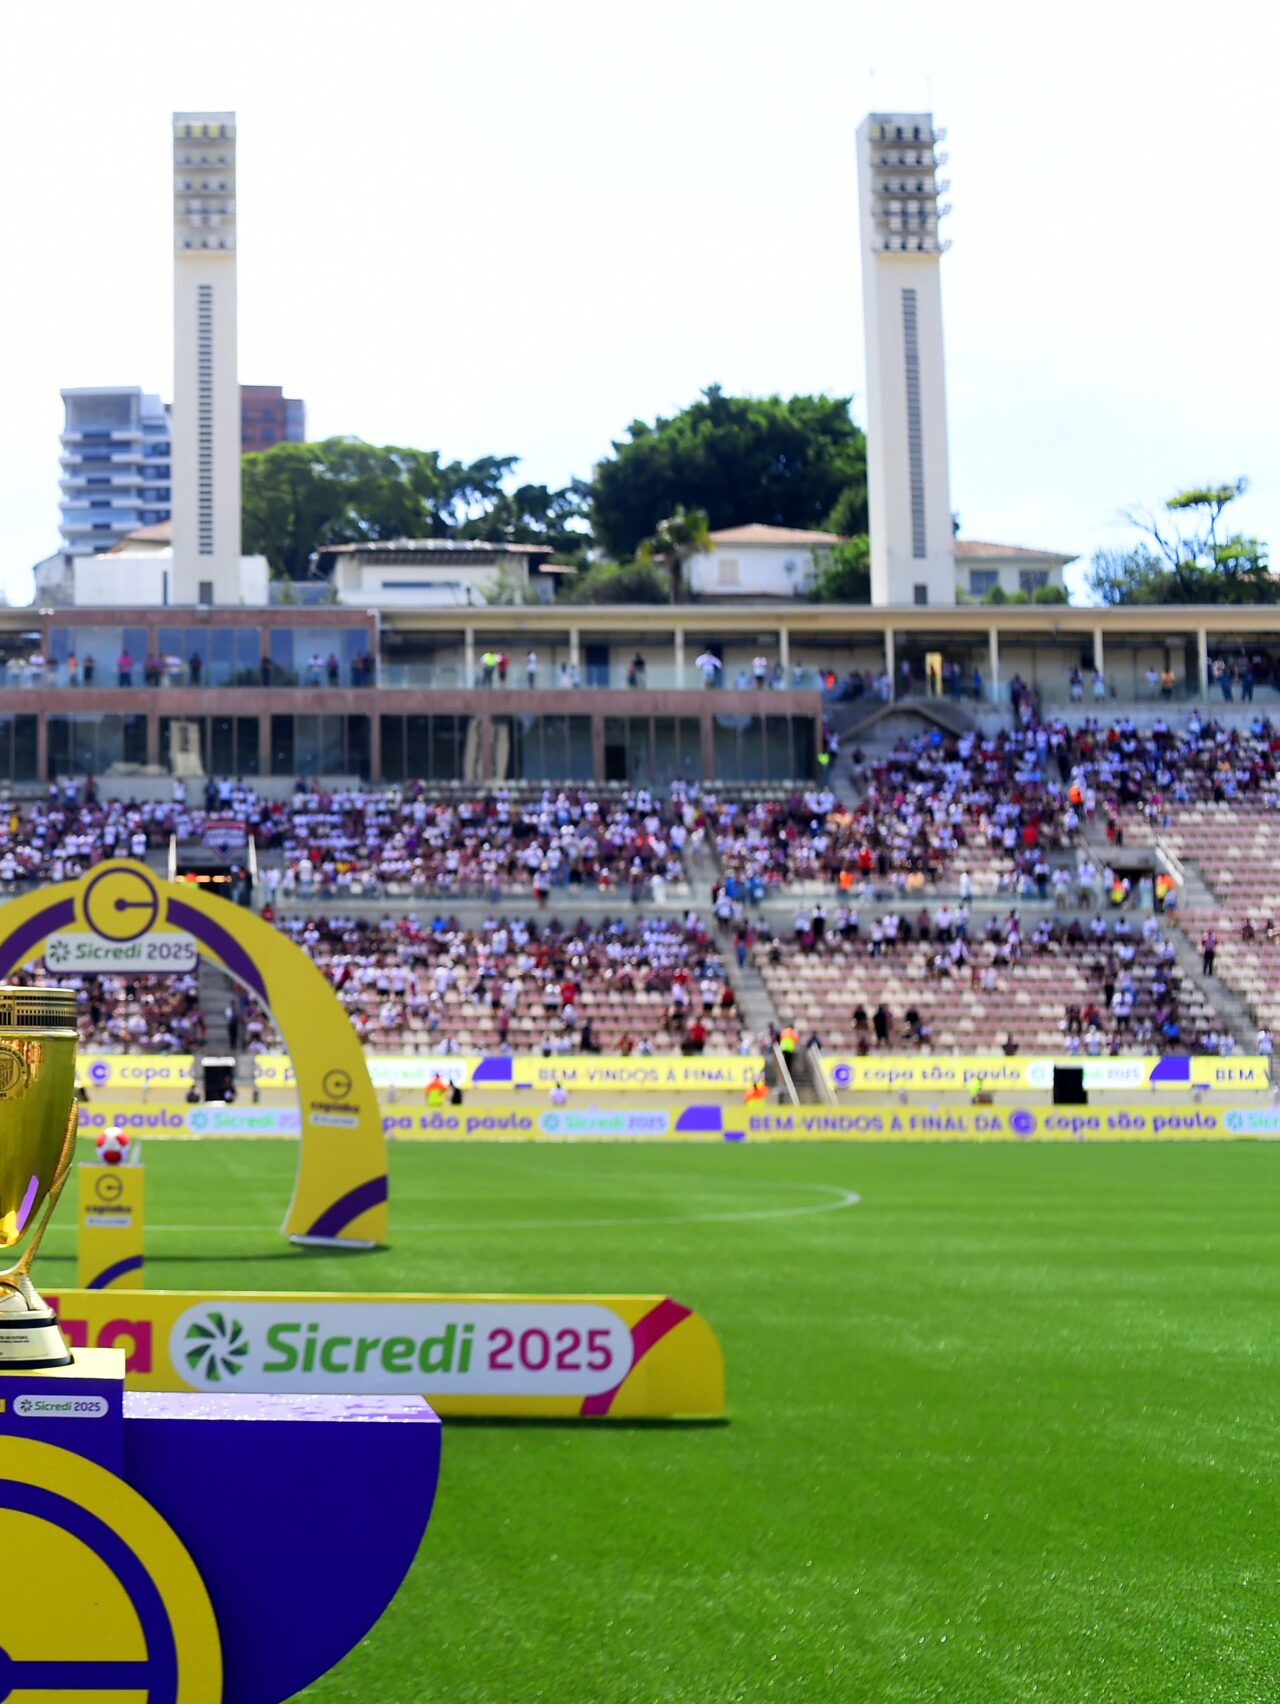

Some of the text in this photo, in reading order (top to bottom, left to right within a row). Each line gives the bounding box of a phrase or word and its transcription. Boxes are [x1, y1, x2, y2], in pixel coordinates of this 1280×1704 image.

[75, 942, 195, 960] Sicredi 2025
[120, 1067, 170, 1081] copa
[864, 1069, 914, 1083] copa
[963, 1067, 1021, 1083] paulo
[78, 1109, 106, 1127] ão
[113, 1109, 184, 1130] paulo
[420, 1112, 459, 1130] são
[466, 1112, 532, 1133] paulo
[910, 1115, 968, 1132] FINAL
[1045, 1115, 1100, 1133] copa
[1108, 1111, 1145, 1129] são
[1153, 1111, 1218, 1133] paulo
[262, 1322, 476, 1374] Sicredi
[487, 1327, 613, 1372] 2025
[34, 1400, 72, 1412] Sicredi
[73, 1401, 102, 1413] 2025
